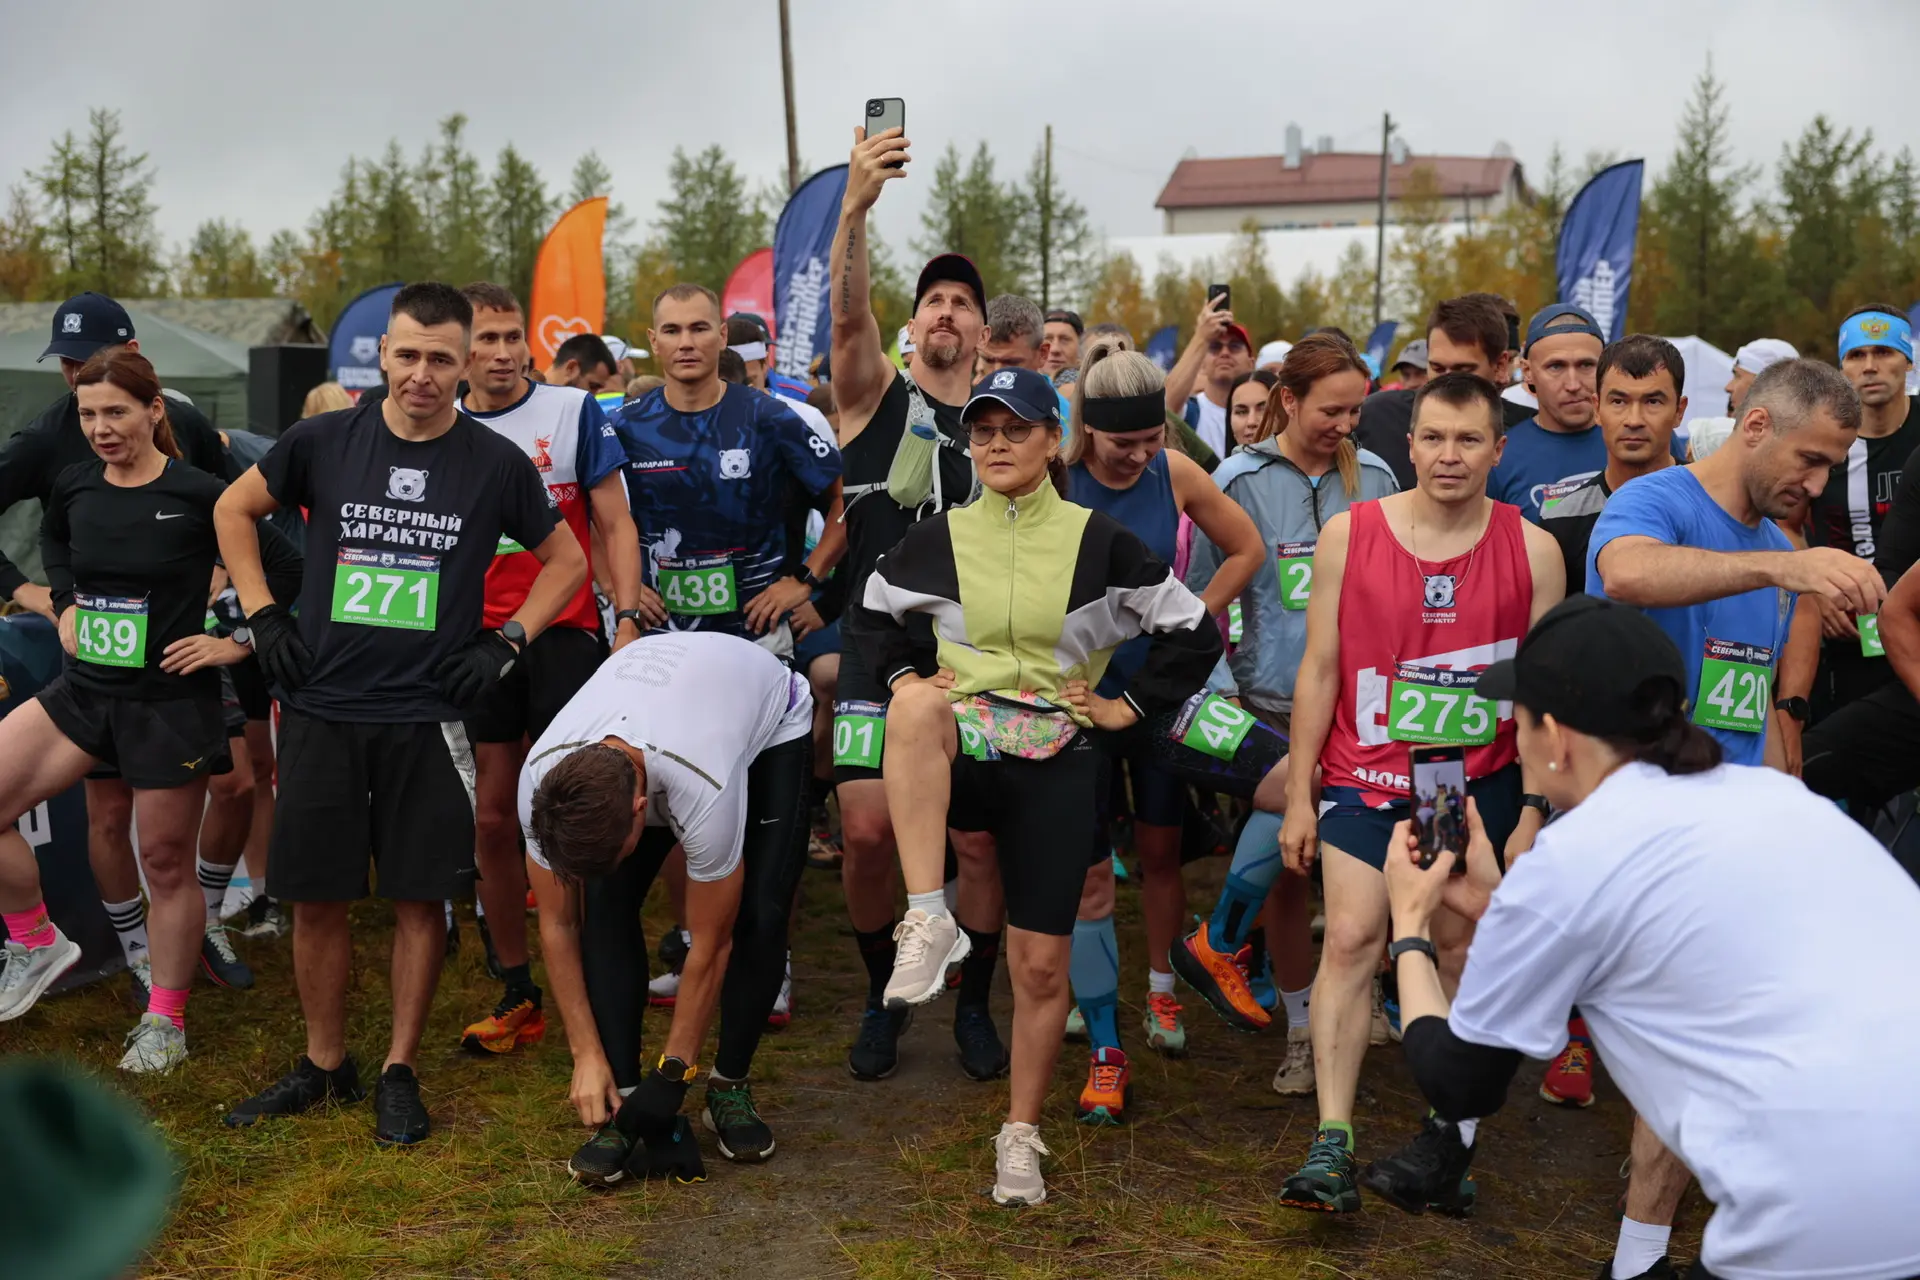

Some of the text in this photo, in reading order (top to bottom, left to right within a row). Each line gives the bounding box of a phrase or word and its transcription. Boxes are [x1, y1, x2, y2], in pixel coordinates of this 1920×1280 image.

[339, 520, 459, 551] ХАРАКТЕР
[341, 502, 463, 532] СЕВЕРНЫЙ
[343, 553, 378, 563] СЕВЕРНЫЙ
[343, 571, 429, 619] 271
[666, 571, 730, 608] 438
[1287, 562, 1313, 600] 2
[79, 616, 138, 658] 439
[1711, 646, 1746, 657] СЕВЕРНЫЙ
[1400, 670, 1436, 681] СЕВЕРНЫЙ
[1396, 689, 1489, 736] 275
[1706, 668, 1768, 721] 420
[834, 720, 874, 757] 01
[1198, 701, 1246, 750] 40
[1351, 766, 1411, 789] ЛЮБ
